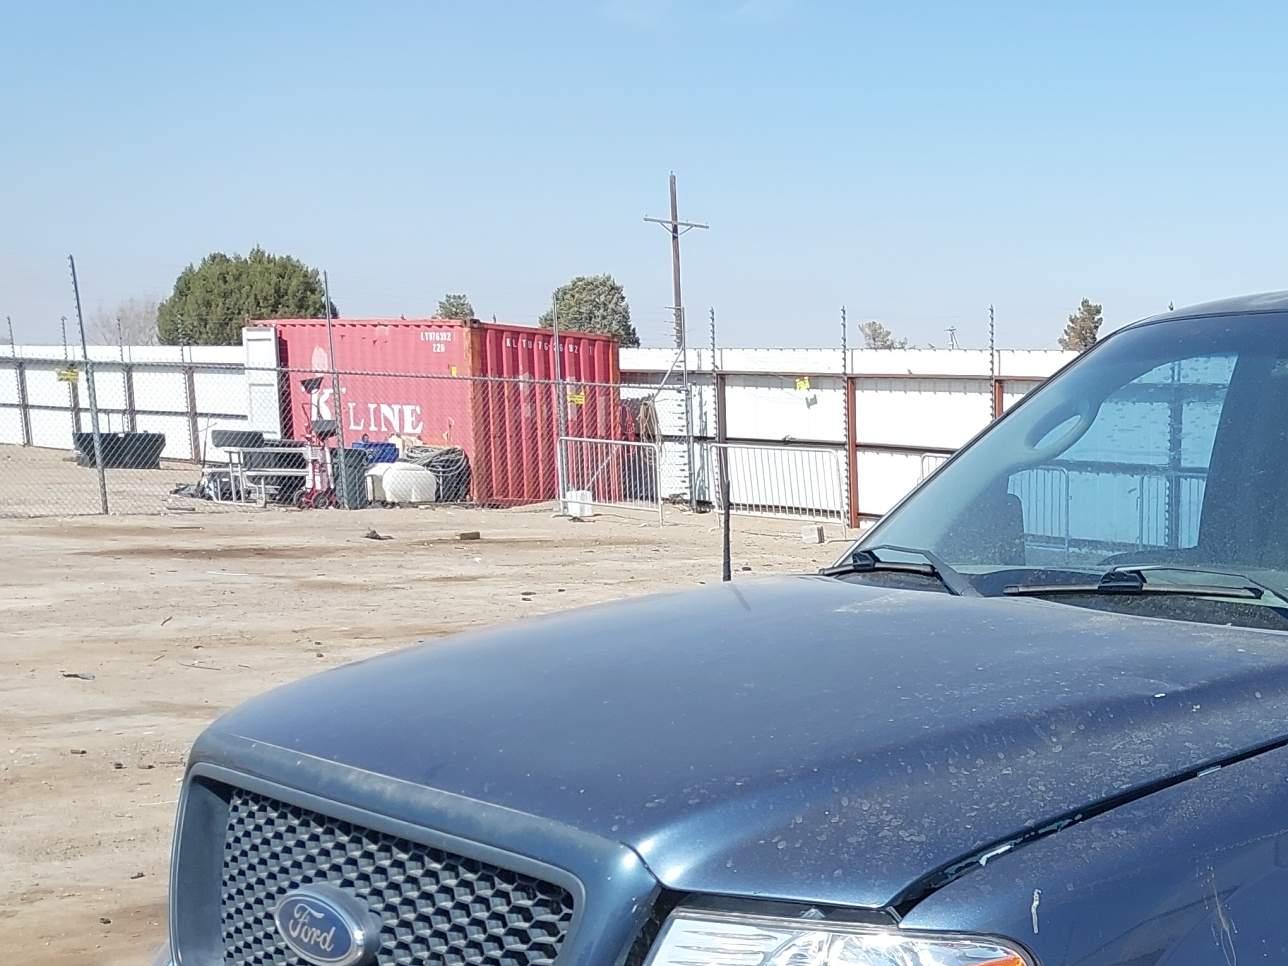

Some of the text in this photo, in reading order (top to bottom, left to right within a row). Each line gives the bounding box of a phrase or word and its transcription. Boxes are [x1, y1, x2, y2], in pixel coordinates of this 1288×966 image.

[302, 388, 424, 434] K LINE
[288, 903, 336, 952] Ford
